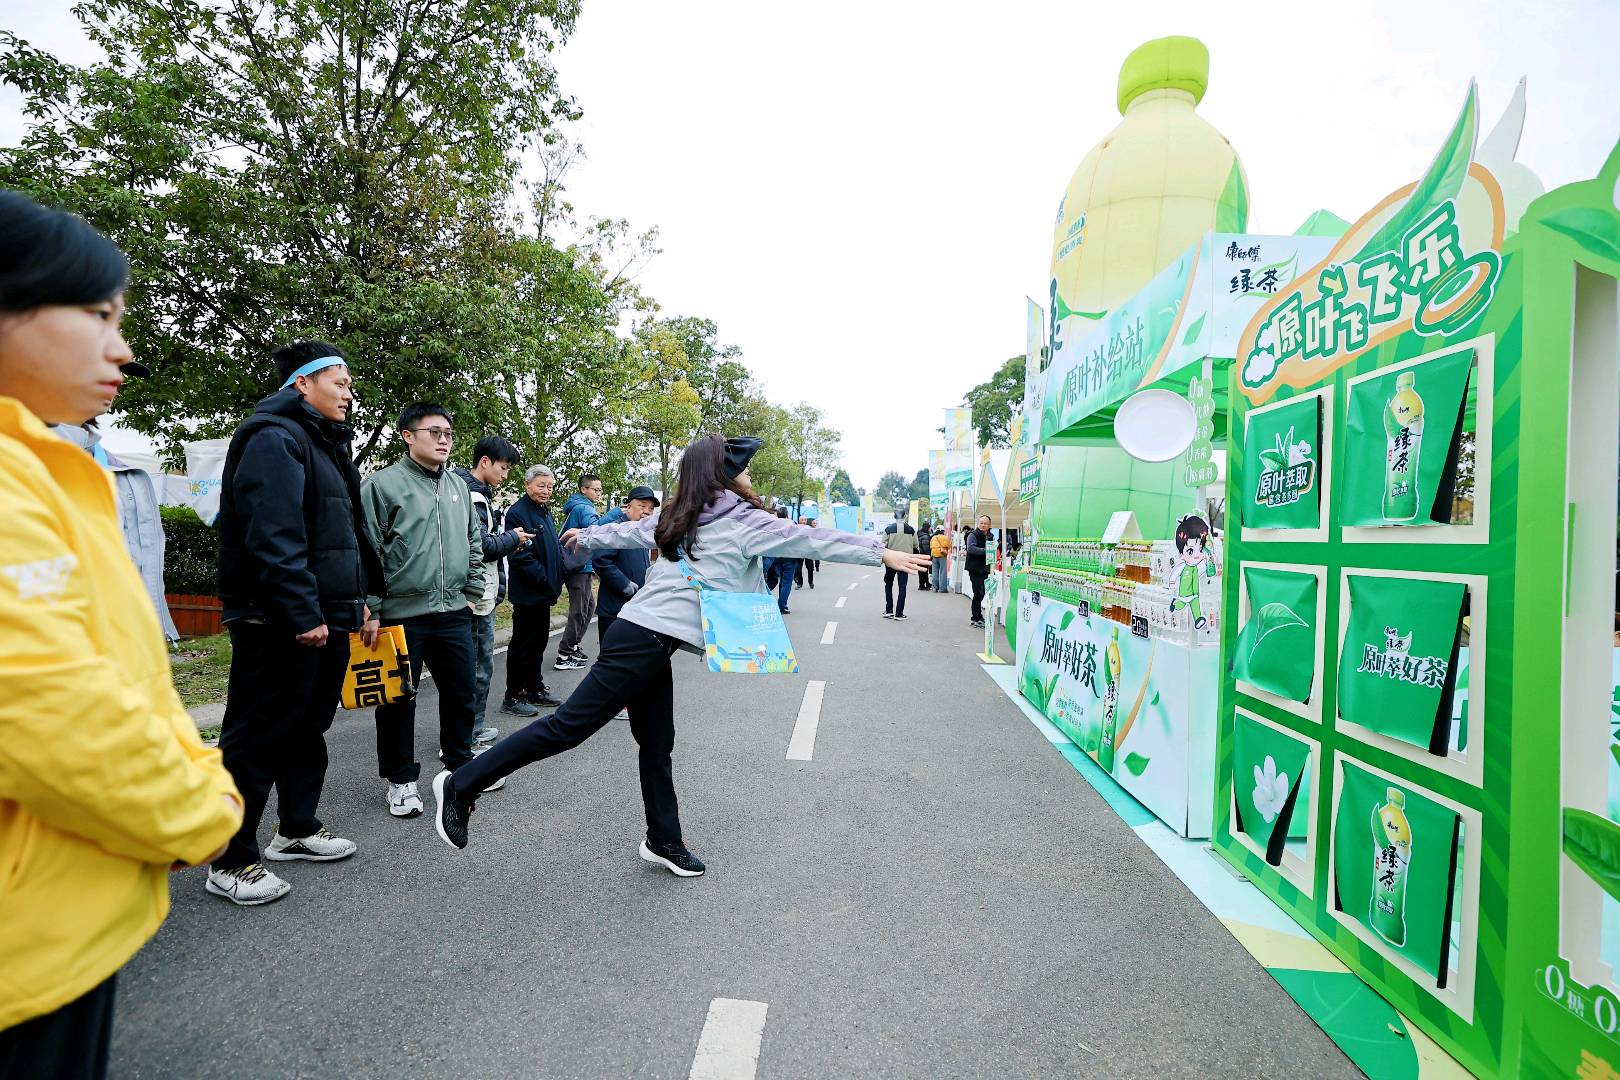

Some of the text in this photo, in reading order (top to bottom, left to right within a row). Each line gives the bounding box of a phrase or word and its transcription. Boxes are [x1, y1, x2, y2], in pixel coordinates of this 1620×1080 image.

[1229, 268, 1278, 294] 绿茶
[1066, 316, 1145, 407] 原叶补给站
[1392, 427, 1412, 473] 绿茶
[1260, 466, 1308, 497] 原叶萃取
[1040, 624, 1100, 698] 原叶萃好茶
[1360, 644, 1448, 688] 原叶萃好茶
[1379, 845, 1398, 892] 绿茶
